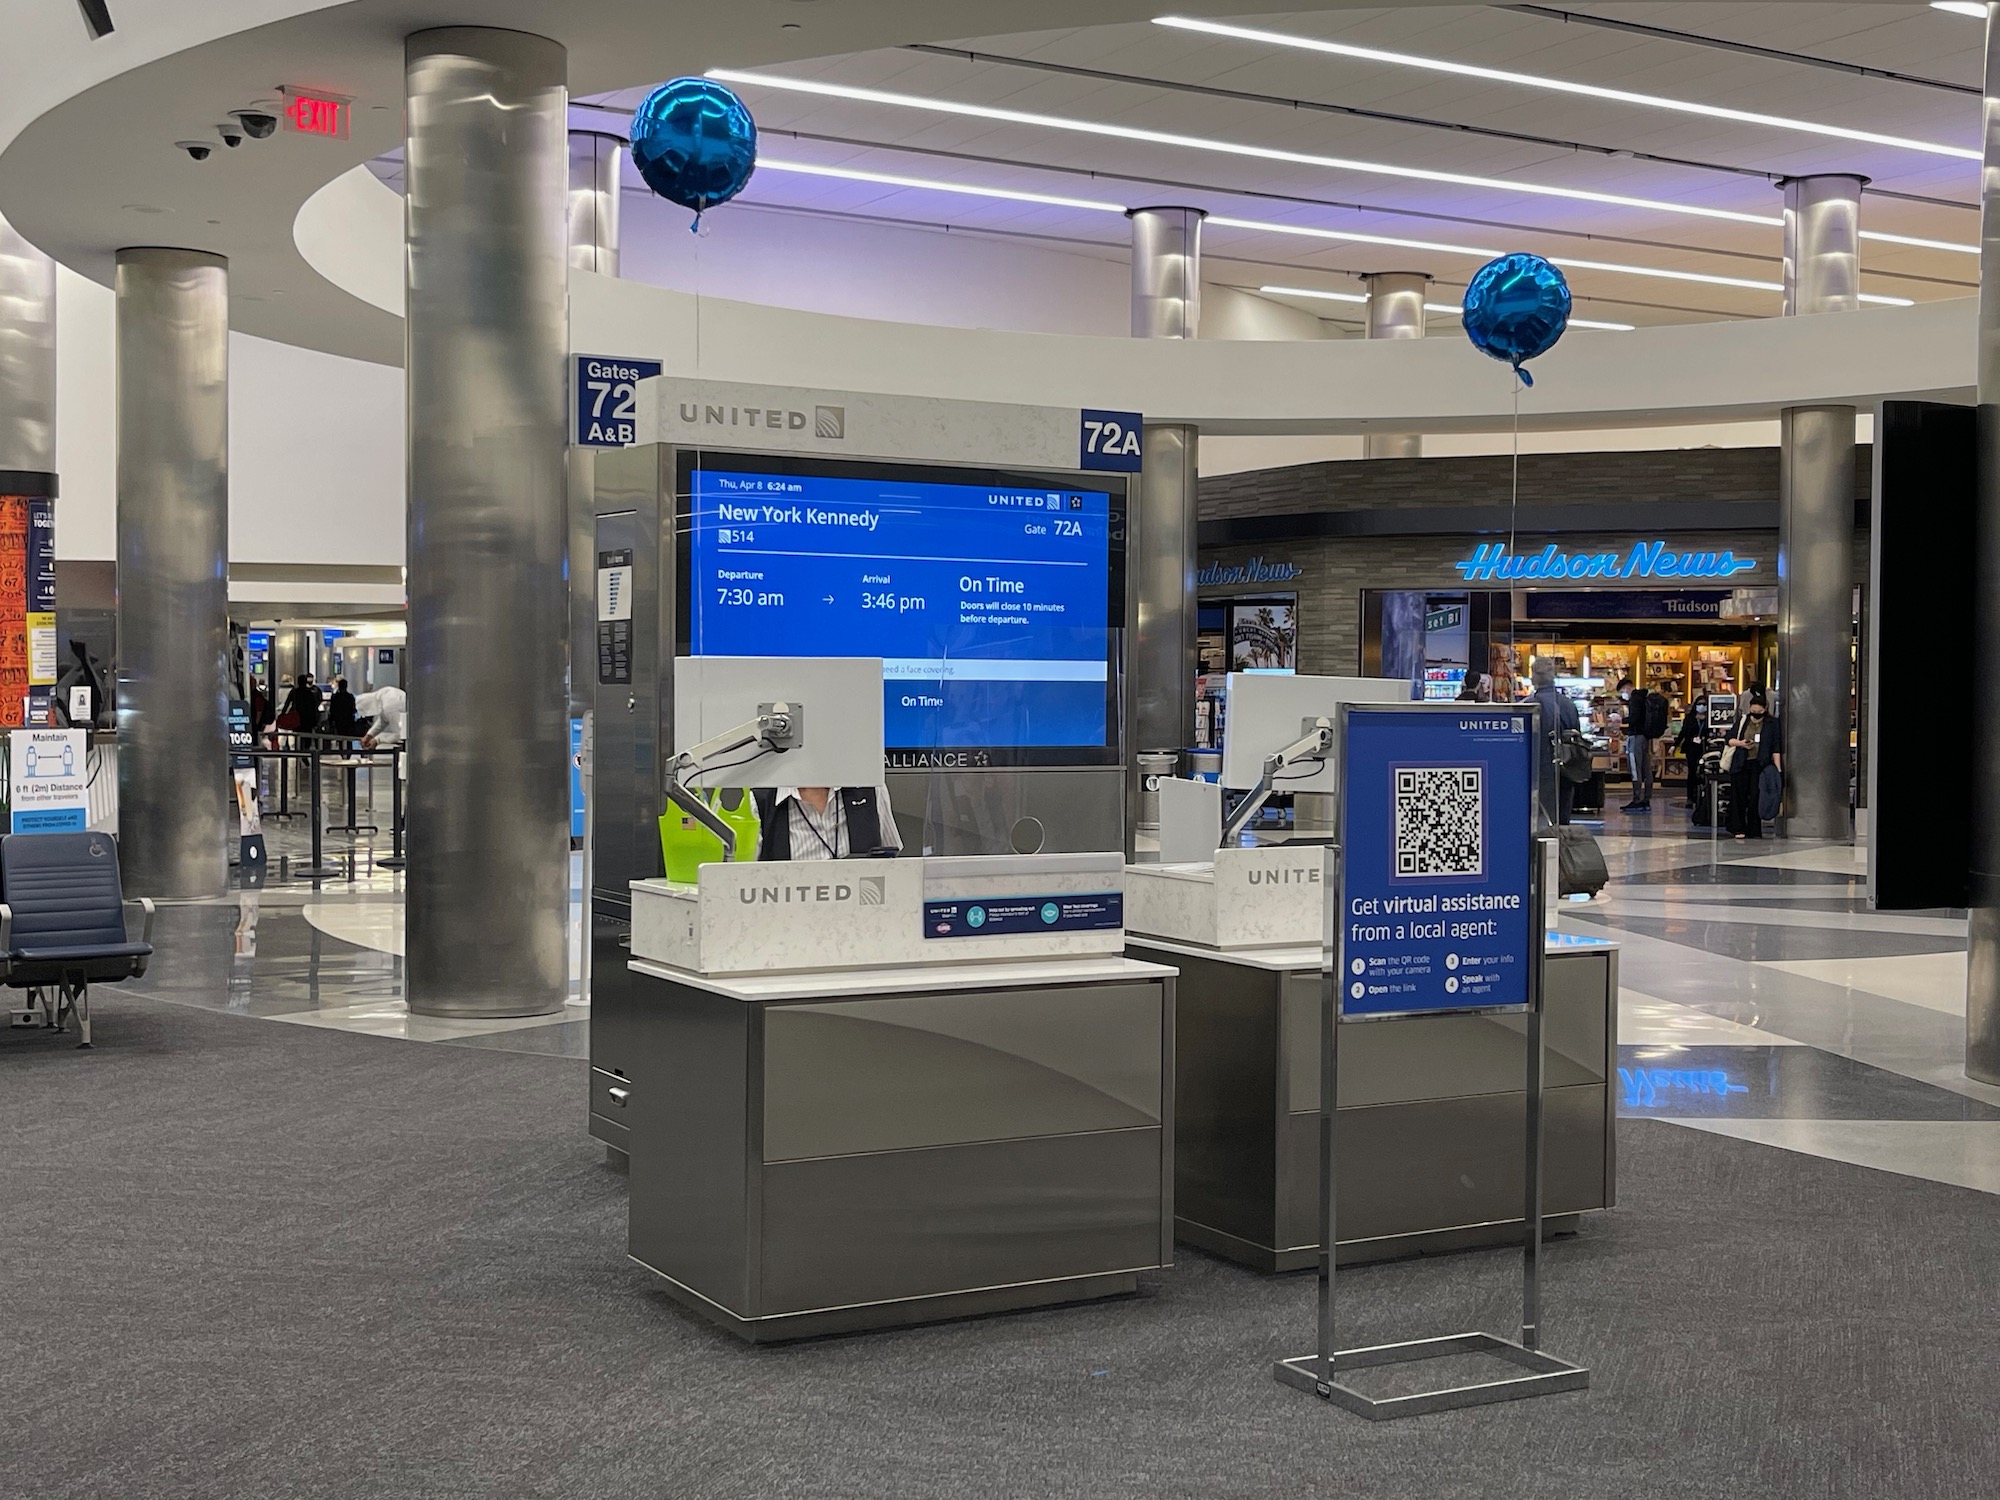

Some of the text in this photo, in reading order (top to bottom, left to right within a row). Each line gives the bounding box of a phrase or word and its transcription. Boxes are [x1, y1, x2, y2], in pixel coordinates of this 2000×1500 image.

[296, 96, 339, 135] EXIT
[587, 362, 639, 380] Gates
[587, 382, 635, 420] 72
[680, 403, 806, 430] UNITED
[588, 422, 633, 443] A&B
[1084, 421, 1141, 456] 72A
[718, 479, 802, 491] Thu, Apr 8 6:24 am
[988, 494, 1044, 507] UNITED
[718, 504, 879, 531] New York Kennedy
[1024, 520, 1083, 536] Gate 72A
[732, 530, 754, 543] 514
[1456, 541, 1756, 580] Hudson News
[717, 569, 764, 581] Departure
[1197, 556, 1303, 586] udson News
[4, 578, 18, 587] 67
[862, 575, 891, 584] Arrival
[960, 576, 1024, 594] On Time
[717, 588, 784, 606] 7:30 am
[861, 593, 925, 614] 3:46 pm
[960, 601, 1065, 612] Doors will close 10 minutes
[1662, 599, 1719, 613] Hudson
[960, 614, 1030, 626] before departure.
[1427, 615, 1443, 629] set
[906, 665, 922, 674] face
[901, 696, 944, 707] On Time
[5, 712, 19, 721] 67
[1460, 720, 1509, 731] UNITED
[32, 733, 68, 742] Maintain
[229, 733, 252, 744] TO GO
[884, 753, 968, 768] ALLIANCE
[16, 783, 84, 793] 6 ft (2m) Distance
[1248, 868, 1320, 885] UNITE
[740, 884, 852, 905] UNITED
[1352, 893, 1520, 915] Get virtual assistance
[1352, 918, 1498, 942] from a local agent:
[1368, 957, 1387, 966] Scan
[1388, 957, 1399, 965] the
[1401, 955, 1412, 965] QR
[1413, 955, 1431, 964] code
[1462, 957, 1482, 966] Enter
[1482, 956, 1499, 966] your
[1500, 954, 1515, 963] info
[1368, 966, 1431, 977] with your camera
[1461, 974, 1483, 985] Speak
[1484, 974, 1500, 982] with
[1368, 985, 1388, 995] Open
[1389, 984, 1401, 993] the
[1402, 983, 1417, 992] link
[1461, 984, 1491, 995] an agent
